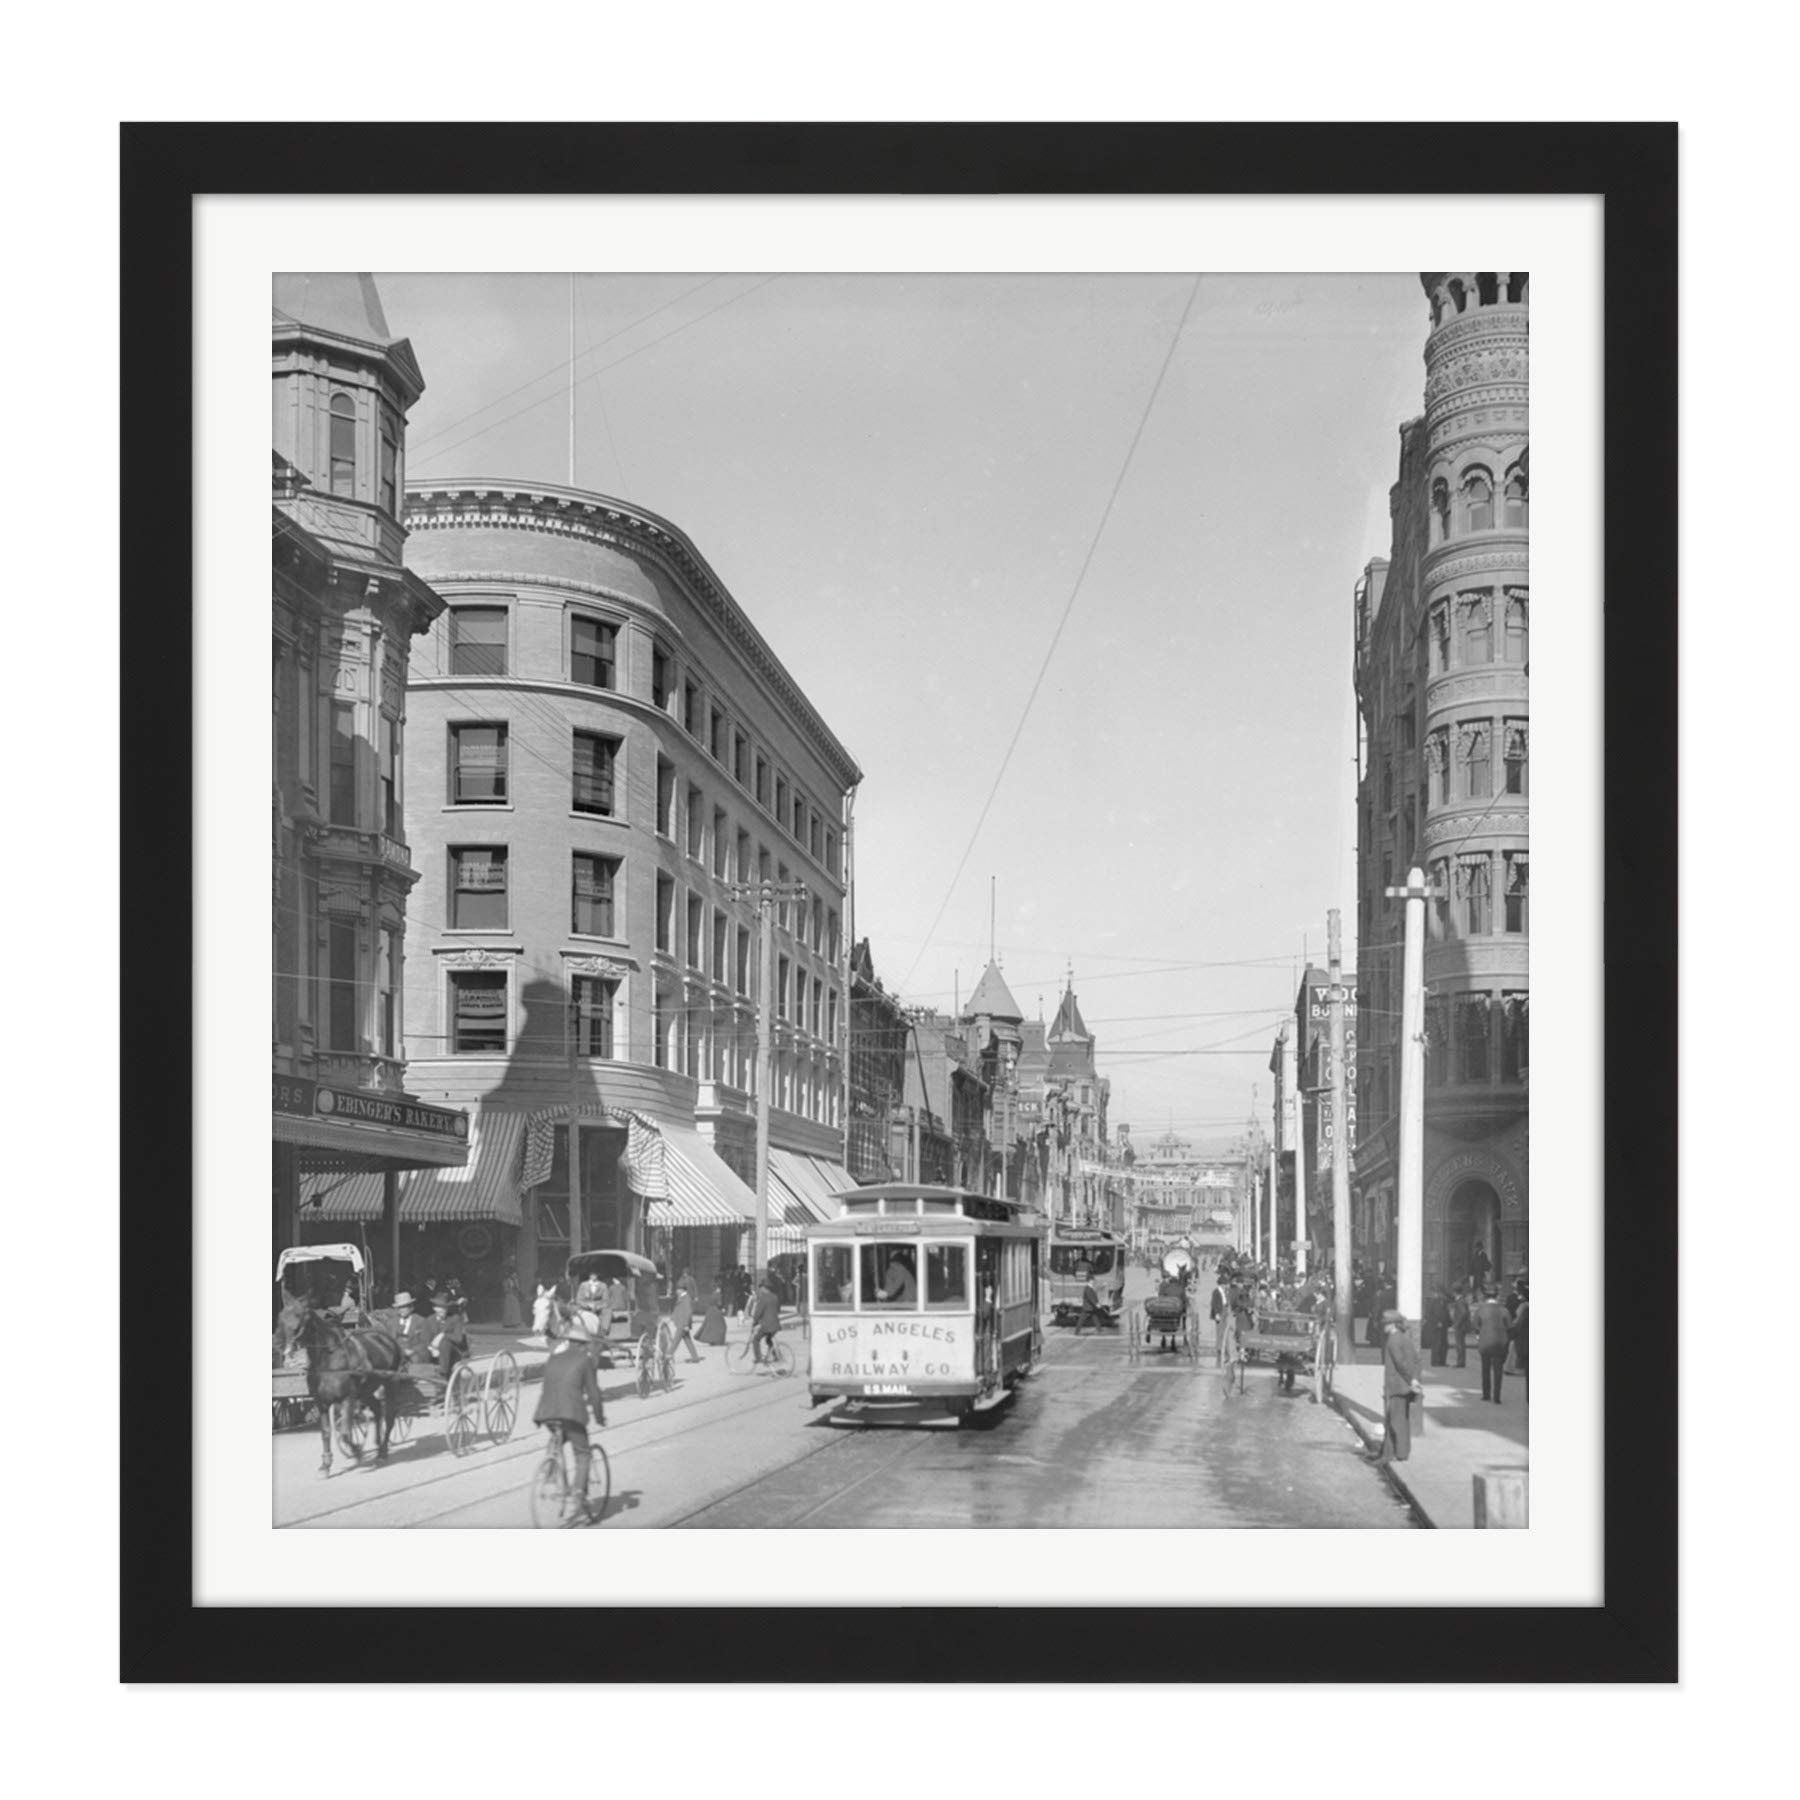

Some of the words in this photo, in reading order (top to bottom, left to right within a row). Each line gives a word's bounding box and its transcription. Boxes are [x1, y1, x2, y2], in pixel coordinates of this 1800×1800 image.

[337, 1094, 402, 1122] EBINGER'S
[827, 1325, 858, 1343] LOS
[873, 1321, 956, 1344] ANGELES
[832, 1362, 910, 1376] RAILWAY
